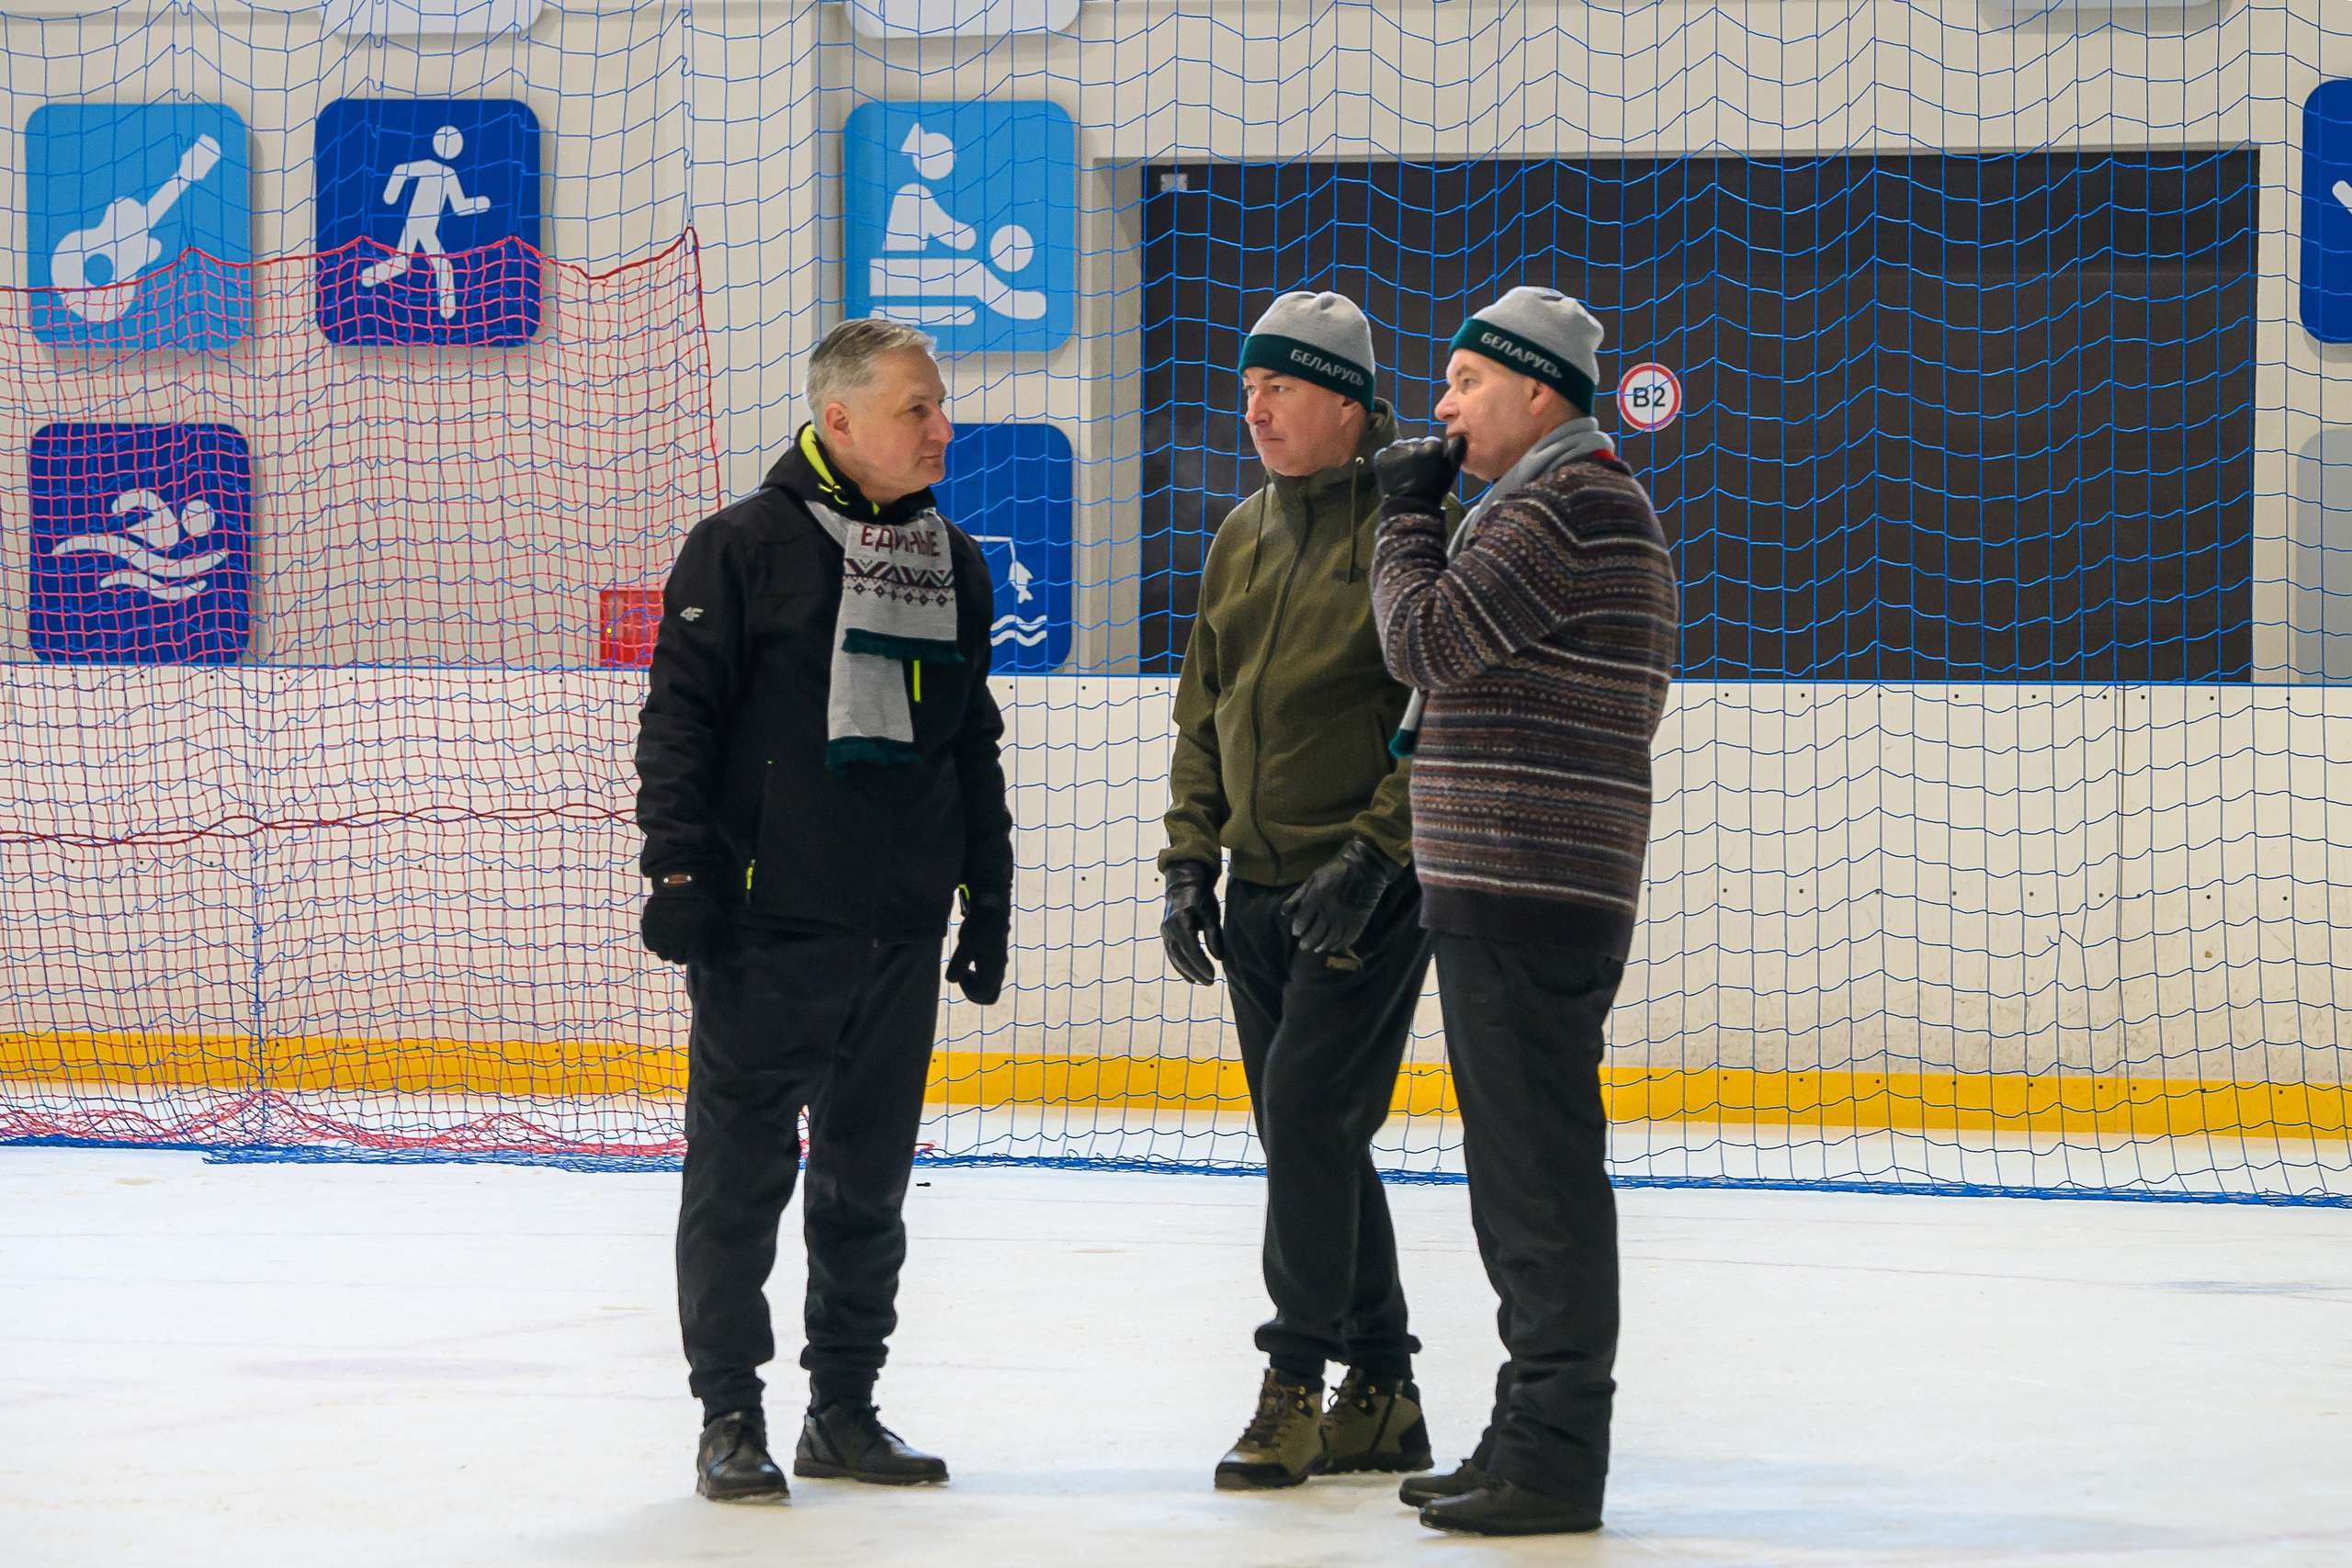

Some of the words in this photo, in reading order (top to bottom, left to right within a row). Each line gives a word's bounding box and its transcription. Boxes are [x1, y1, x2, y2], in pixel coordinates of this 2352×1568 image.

[1290, 348, 1364, 386] БЕЛАРУСЬ
[1480, 332, 1562, 378] БЕЛАРУСЬ
[680, 606, 704, 621] 4F
